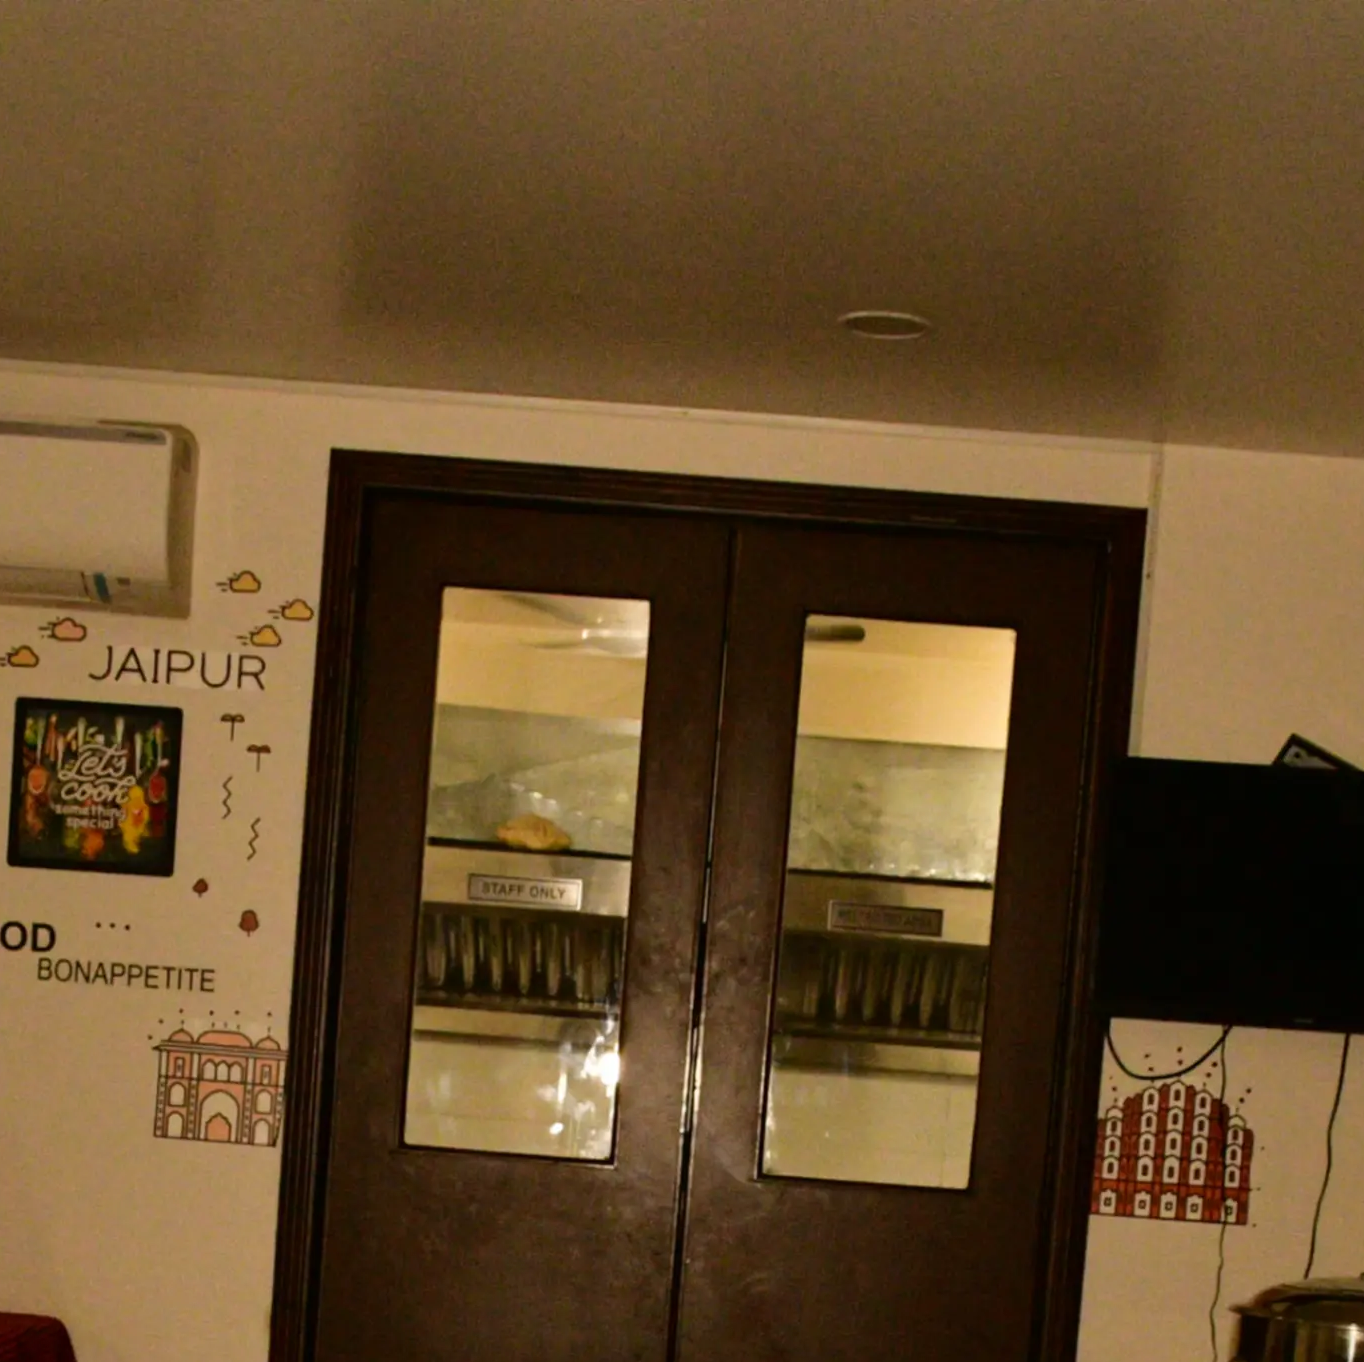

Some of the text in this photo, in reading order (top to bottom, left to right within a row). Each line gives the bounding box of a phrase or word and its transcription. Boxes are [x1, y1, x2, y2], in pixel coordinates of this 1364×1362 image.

[88, 645, 266, 691] JAIPUR
[482, 881, 566, 900] STAFF ONLY
[37, 957, 216, 993] BONAPPETITE
